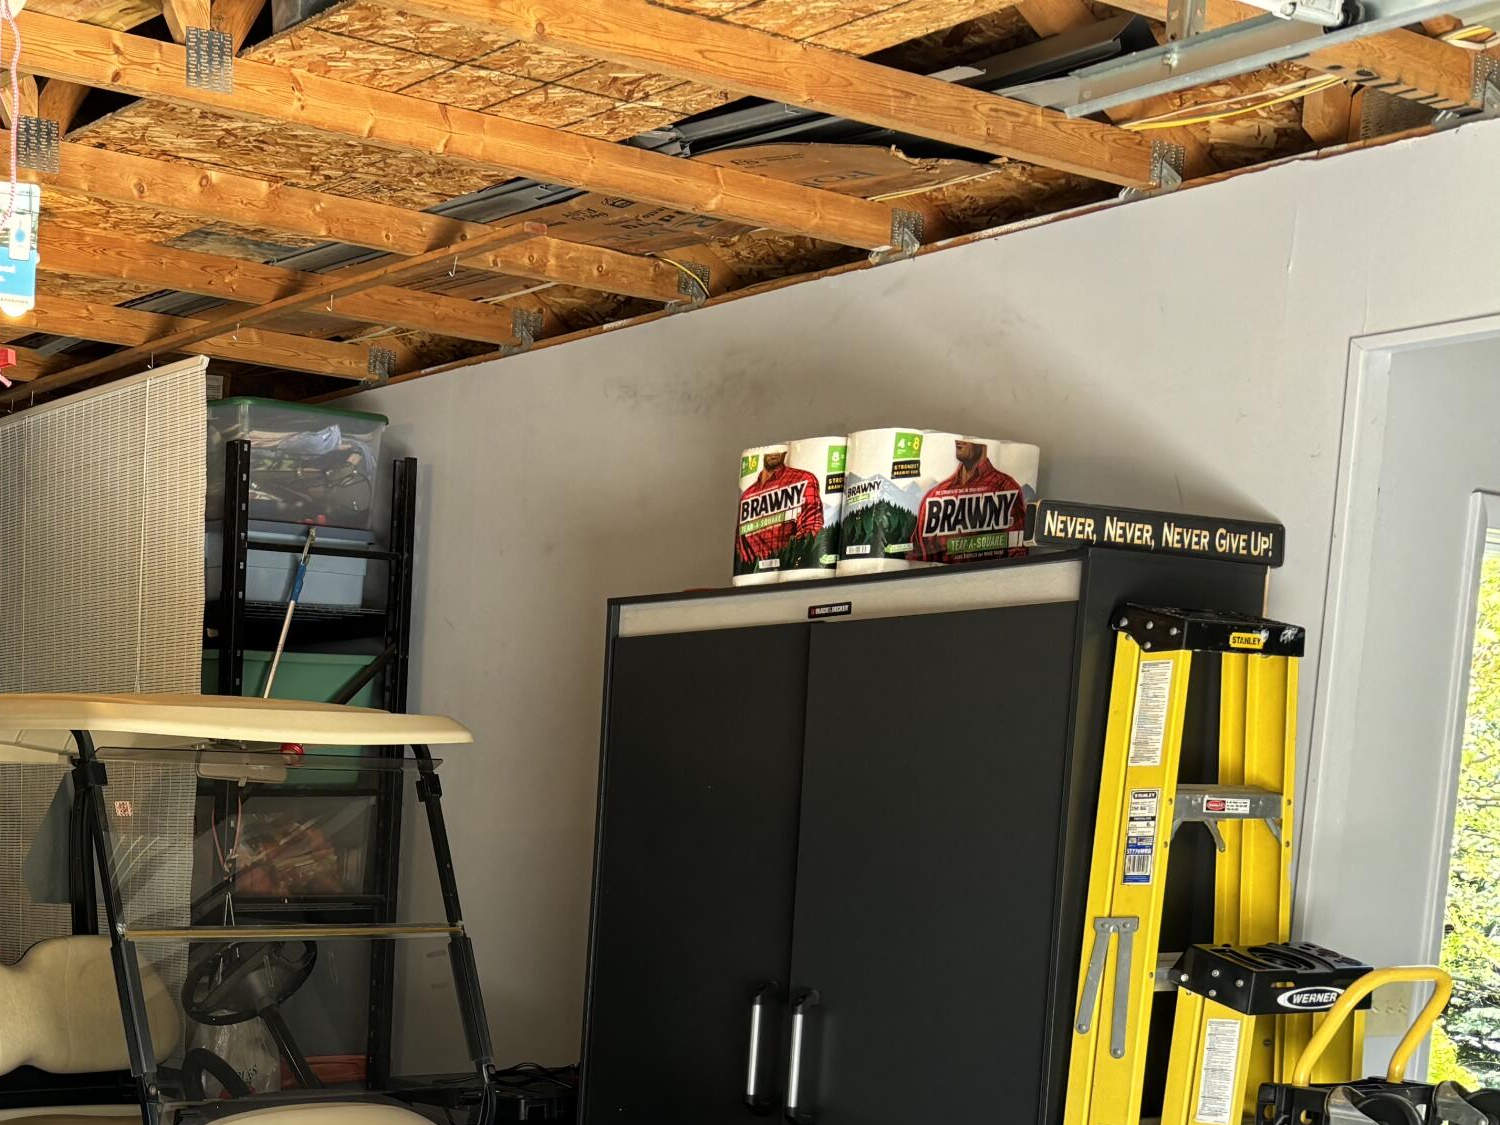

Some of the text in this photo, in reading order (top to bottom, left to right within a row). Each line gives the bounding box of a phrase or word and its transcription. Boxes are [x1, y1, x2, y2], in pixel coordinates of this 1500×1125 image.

[912, 436, 920, 450] 8
[847, 480, 882, 499] BRAWNY
[741, 482, 807, 522] BRAWNY
[925, 492, 1017, 534] BRAWNY
[1231, 635, 1261, 647] STANLEY
[1292, 992, 1338, 1005] WERNER
